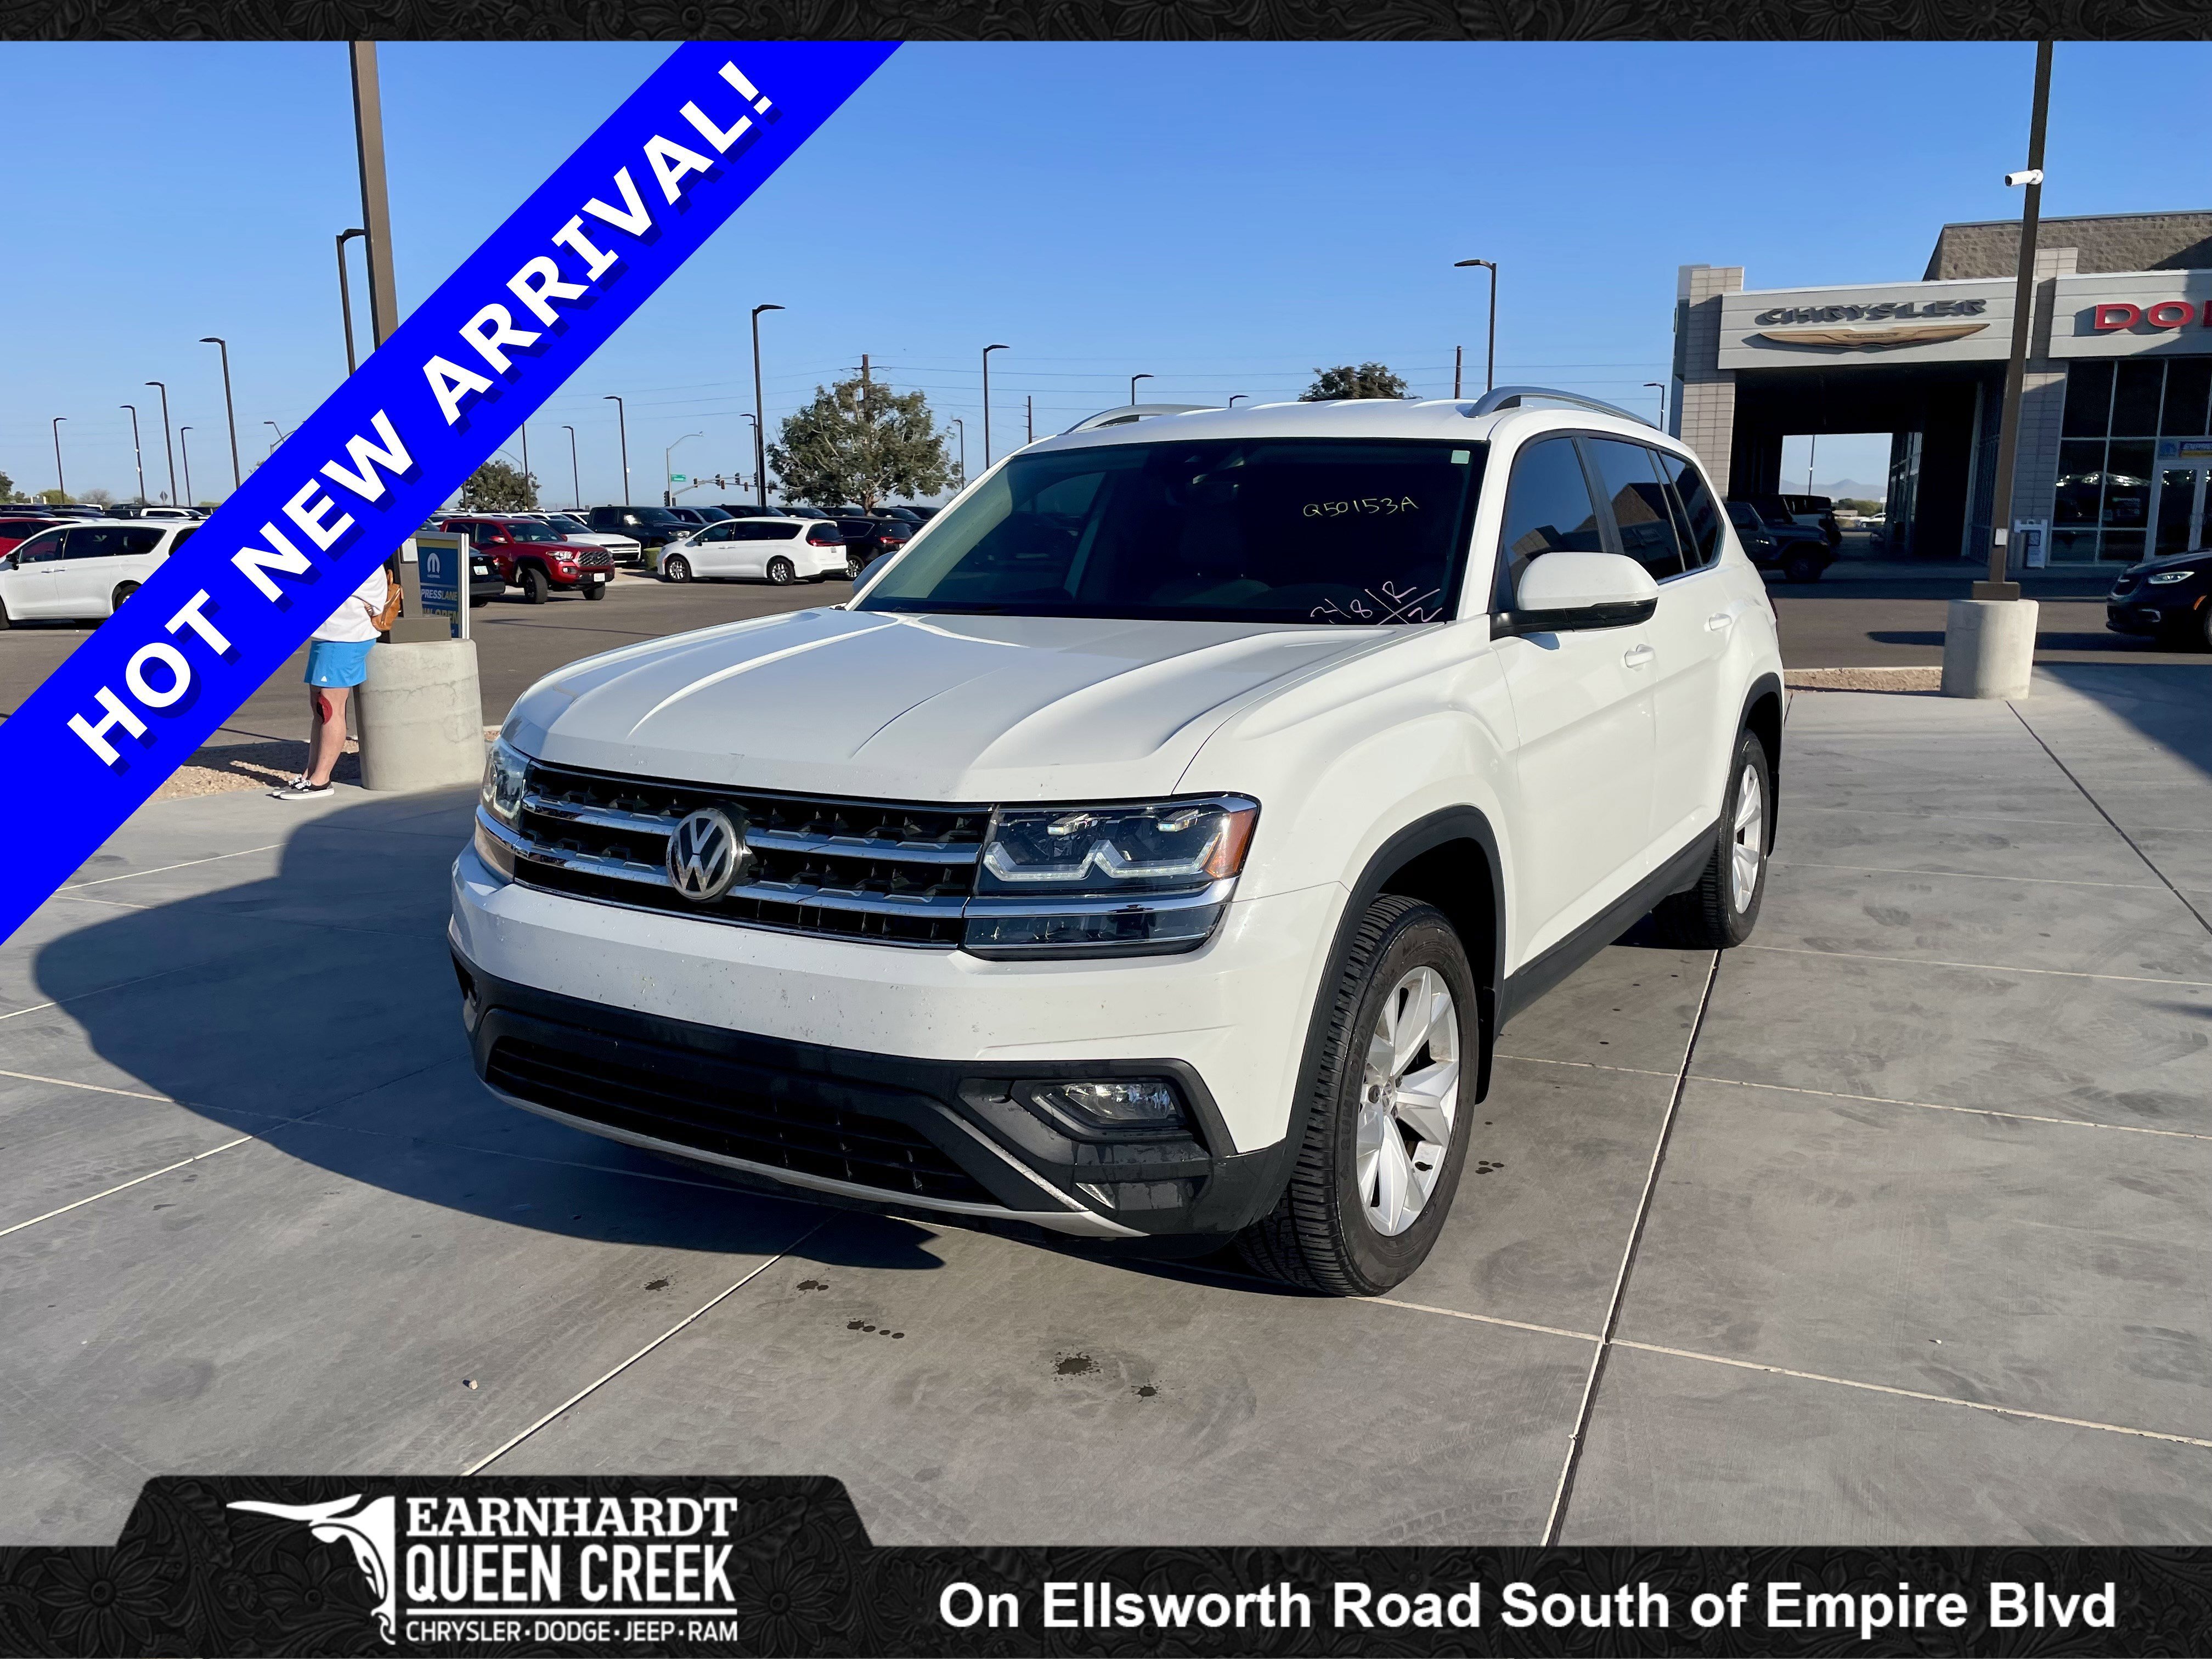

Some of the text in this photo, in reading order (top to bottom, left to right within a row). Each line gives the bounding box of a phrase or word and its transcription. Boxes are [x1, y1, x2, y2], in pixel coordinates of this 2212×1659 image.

[1765, 299, 1987, 321] CHRYSLER
[2094, 301, 2212, 329] DO
[1303, 496, 1419, 517] Q50153A
